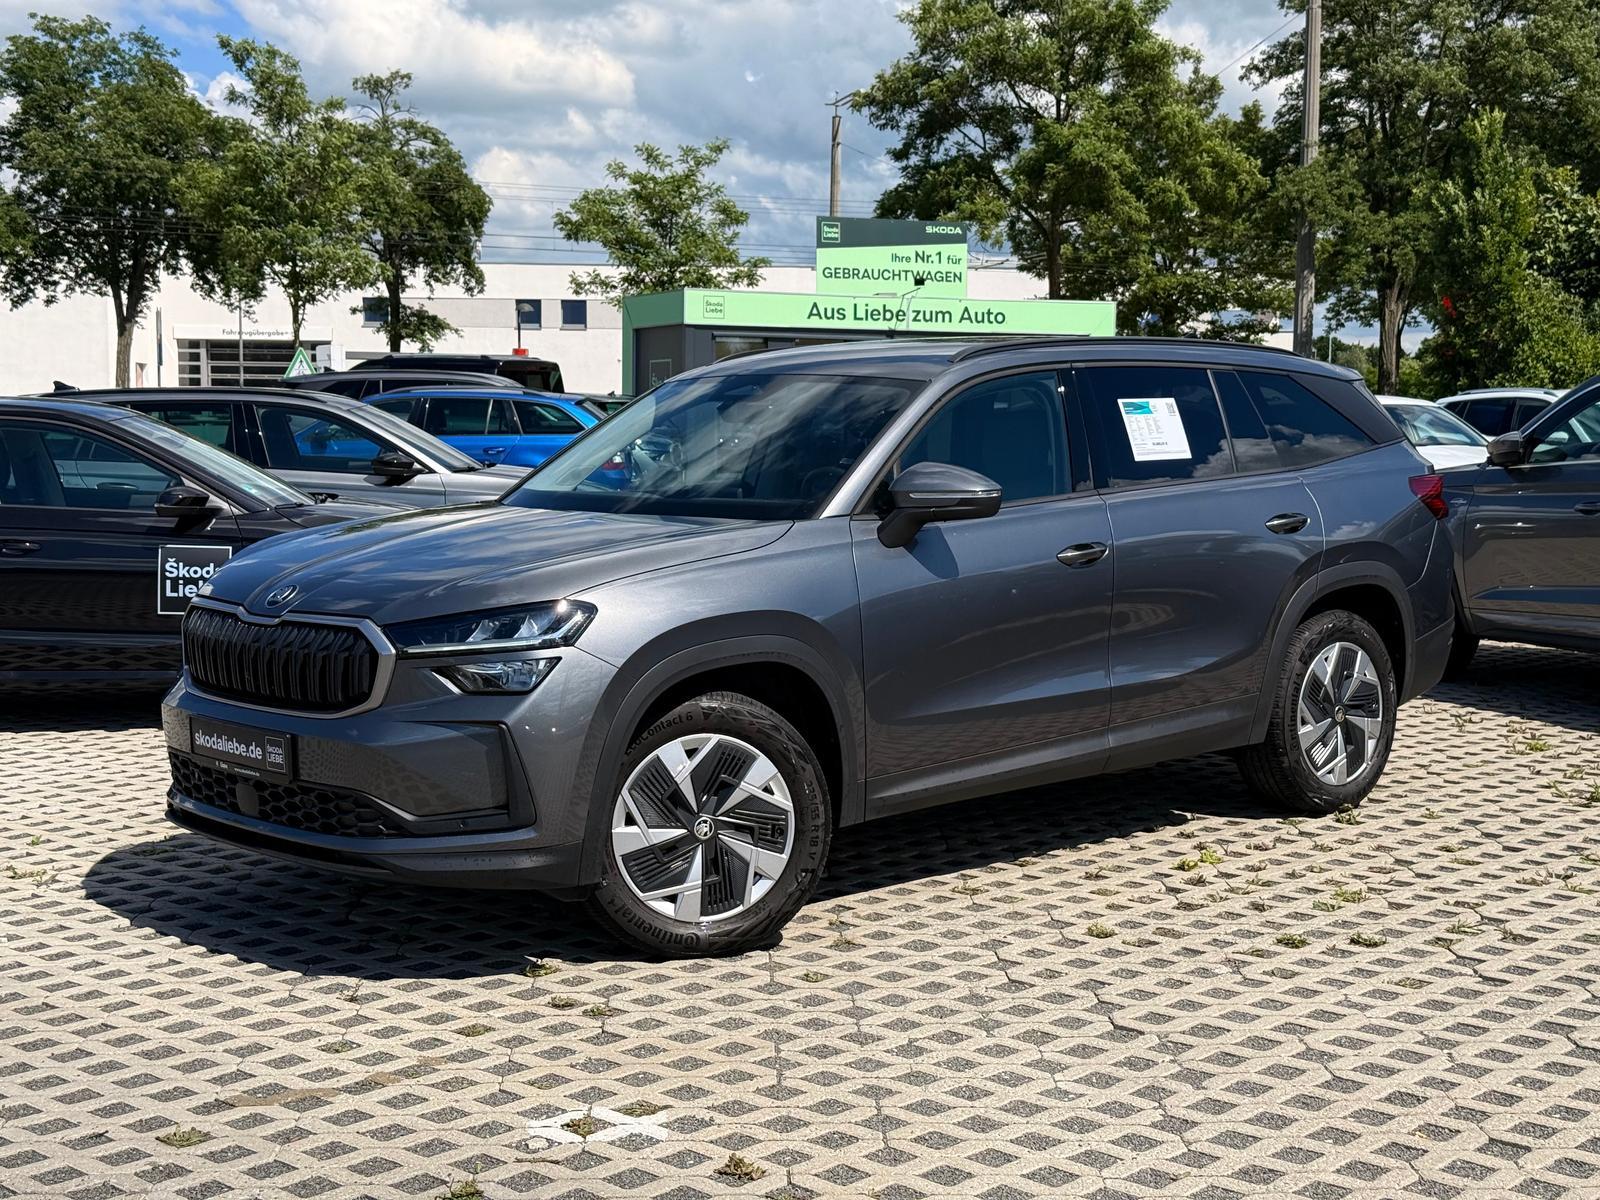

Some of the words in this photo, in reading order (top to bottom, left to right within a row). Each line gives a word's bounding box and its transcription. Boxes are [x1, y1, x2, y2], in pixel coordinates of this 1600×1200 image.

[891, 253, 911, 264] Ihre
[947, 254, 962, 265] für
[822, 266, 963, 283] GEBRAUCHTWAGEN
[807, 302, 846, 320] Aus
[853, 303, 906, 322] Liebe
[912, 309, 952, 324] zum
[958, 306, 1006, 325] Auto
[686, 712, 693, 721] 6
[194, 729, 263, 760] skodaliebe.de
[267, 753, 284, 764] LIEBE
[613, 902, 701, 949] Continental
